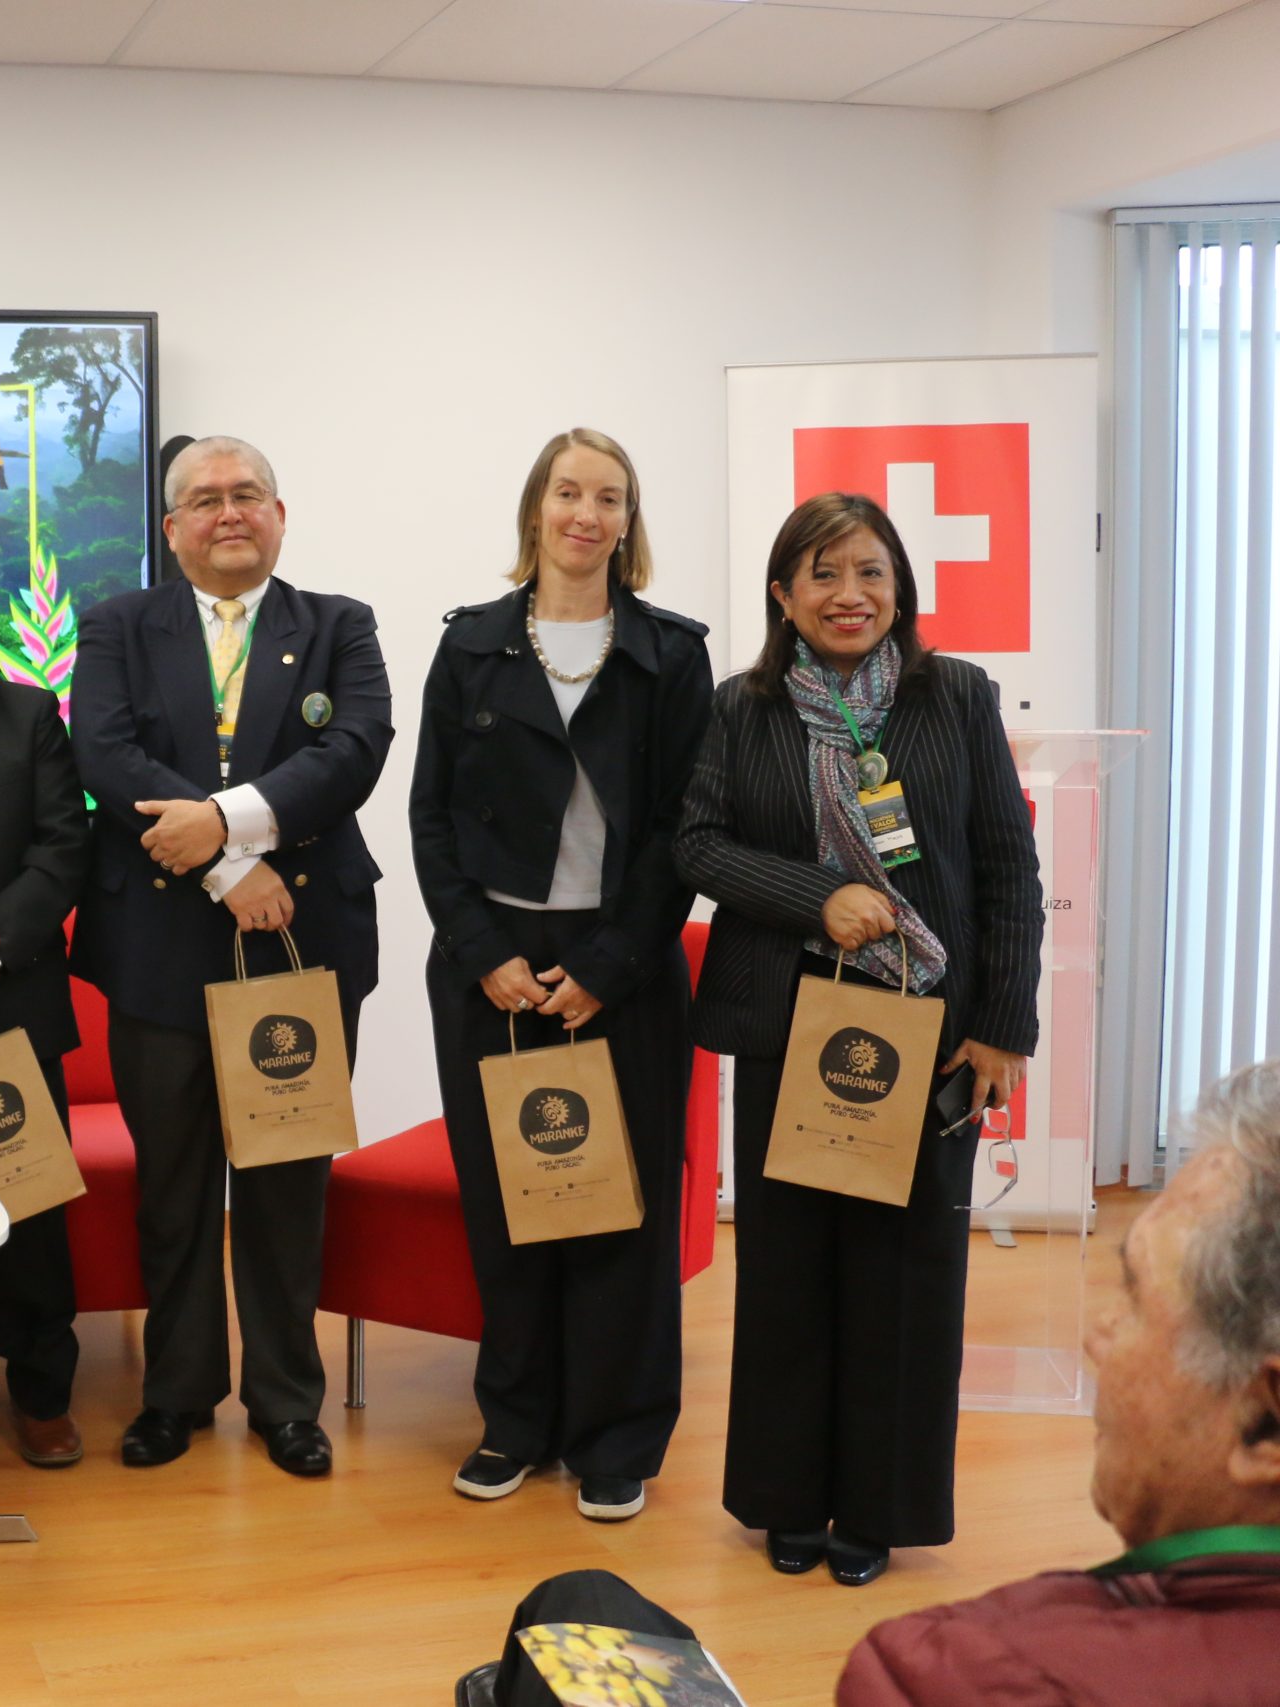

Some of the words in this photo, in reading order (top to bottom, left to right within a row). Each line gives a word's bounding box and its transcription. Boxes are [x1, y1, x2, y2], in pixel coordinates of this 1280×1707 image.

[259, 1051, 312, 1070] MARANKE
[825, 1070, 888, 1094] MARANKE
[529, 1125, 586, 1144] MARANKE
